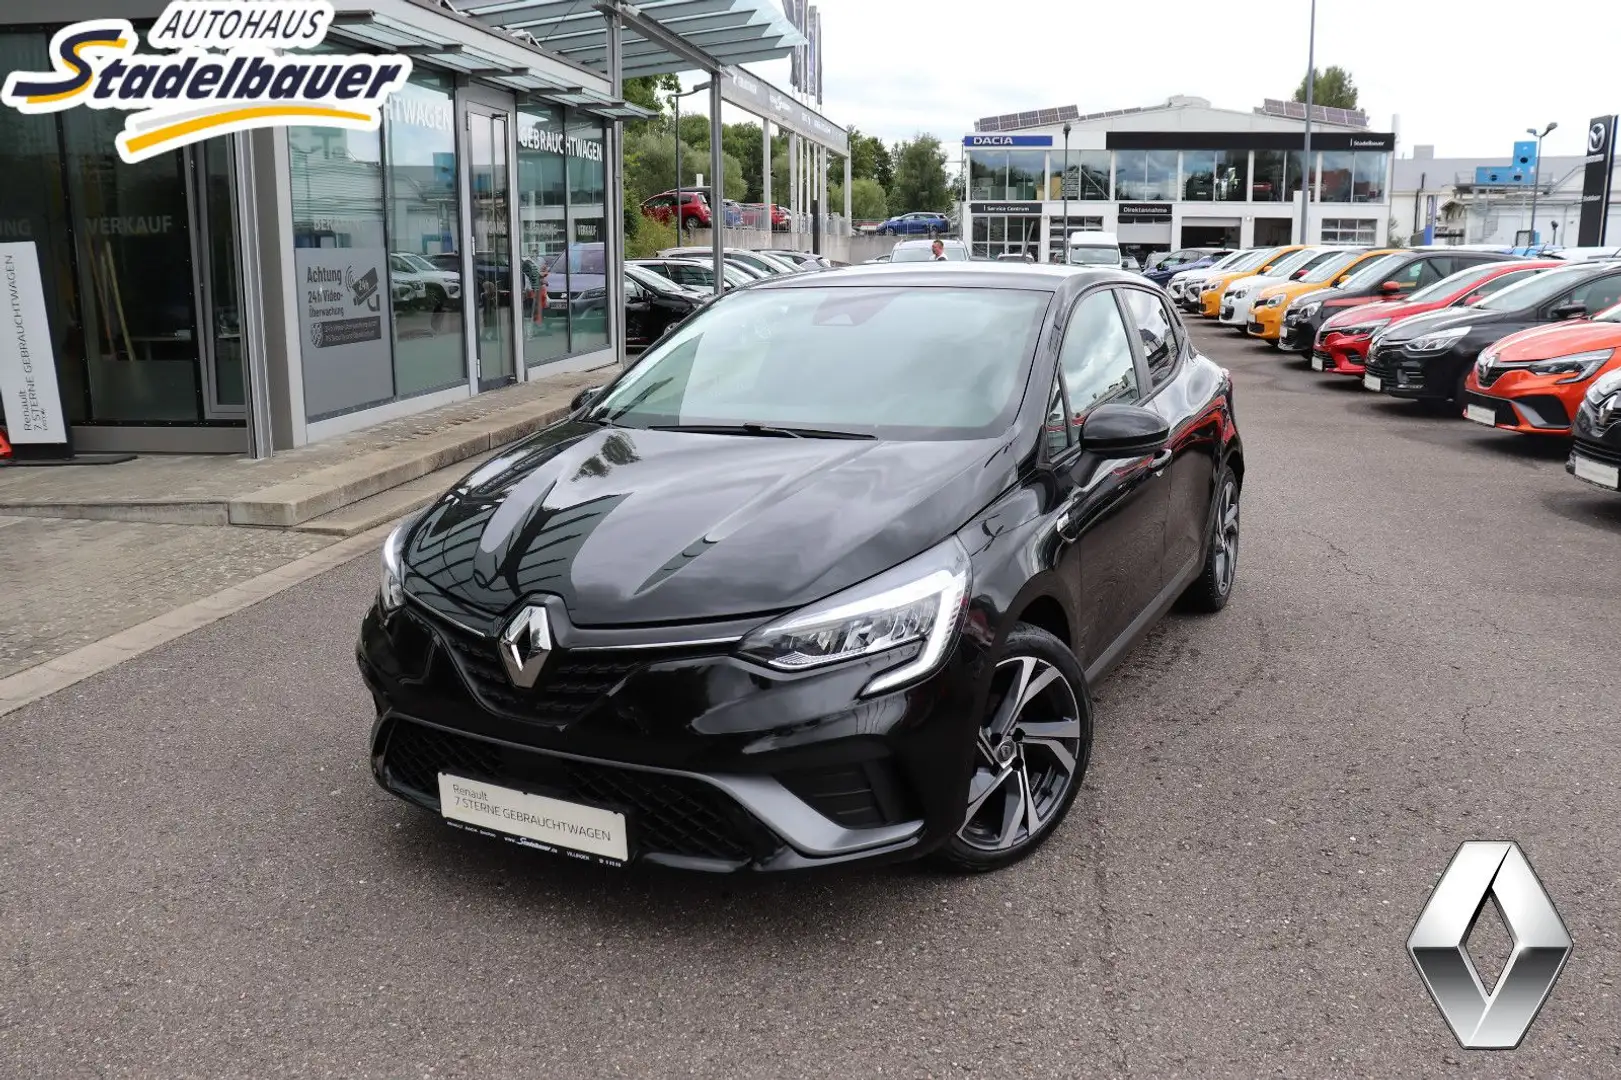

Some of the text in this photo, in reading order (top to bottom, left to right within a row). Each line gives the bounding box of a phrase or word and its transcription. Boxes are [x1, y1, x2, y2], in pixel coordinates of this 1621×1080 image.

[519, 124, 603, 161] GEBRAUCHTWAGEN
[973, 136, 1013, 145] DACIA
[86, 214, 173, 235] VERKAUF
[307, 266, 342, 286] Achtung
[323, 288, 343, 302] Video-
[5, 254, 32, 373] GEBRAUCHTWAGEN
[19, 388, 32, 431] Renault
[25, 375, 41, 422] STERNE
[453, 784, 488, 801] Renault
[454, 796, 461, 806] 7
[463, 799, 501, 817] STERNE
[502, 808, 611, 842] GEBRAUCHTWAGEN
